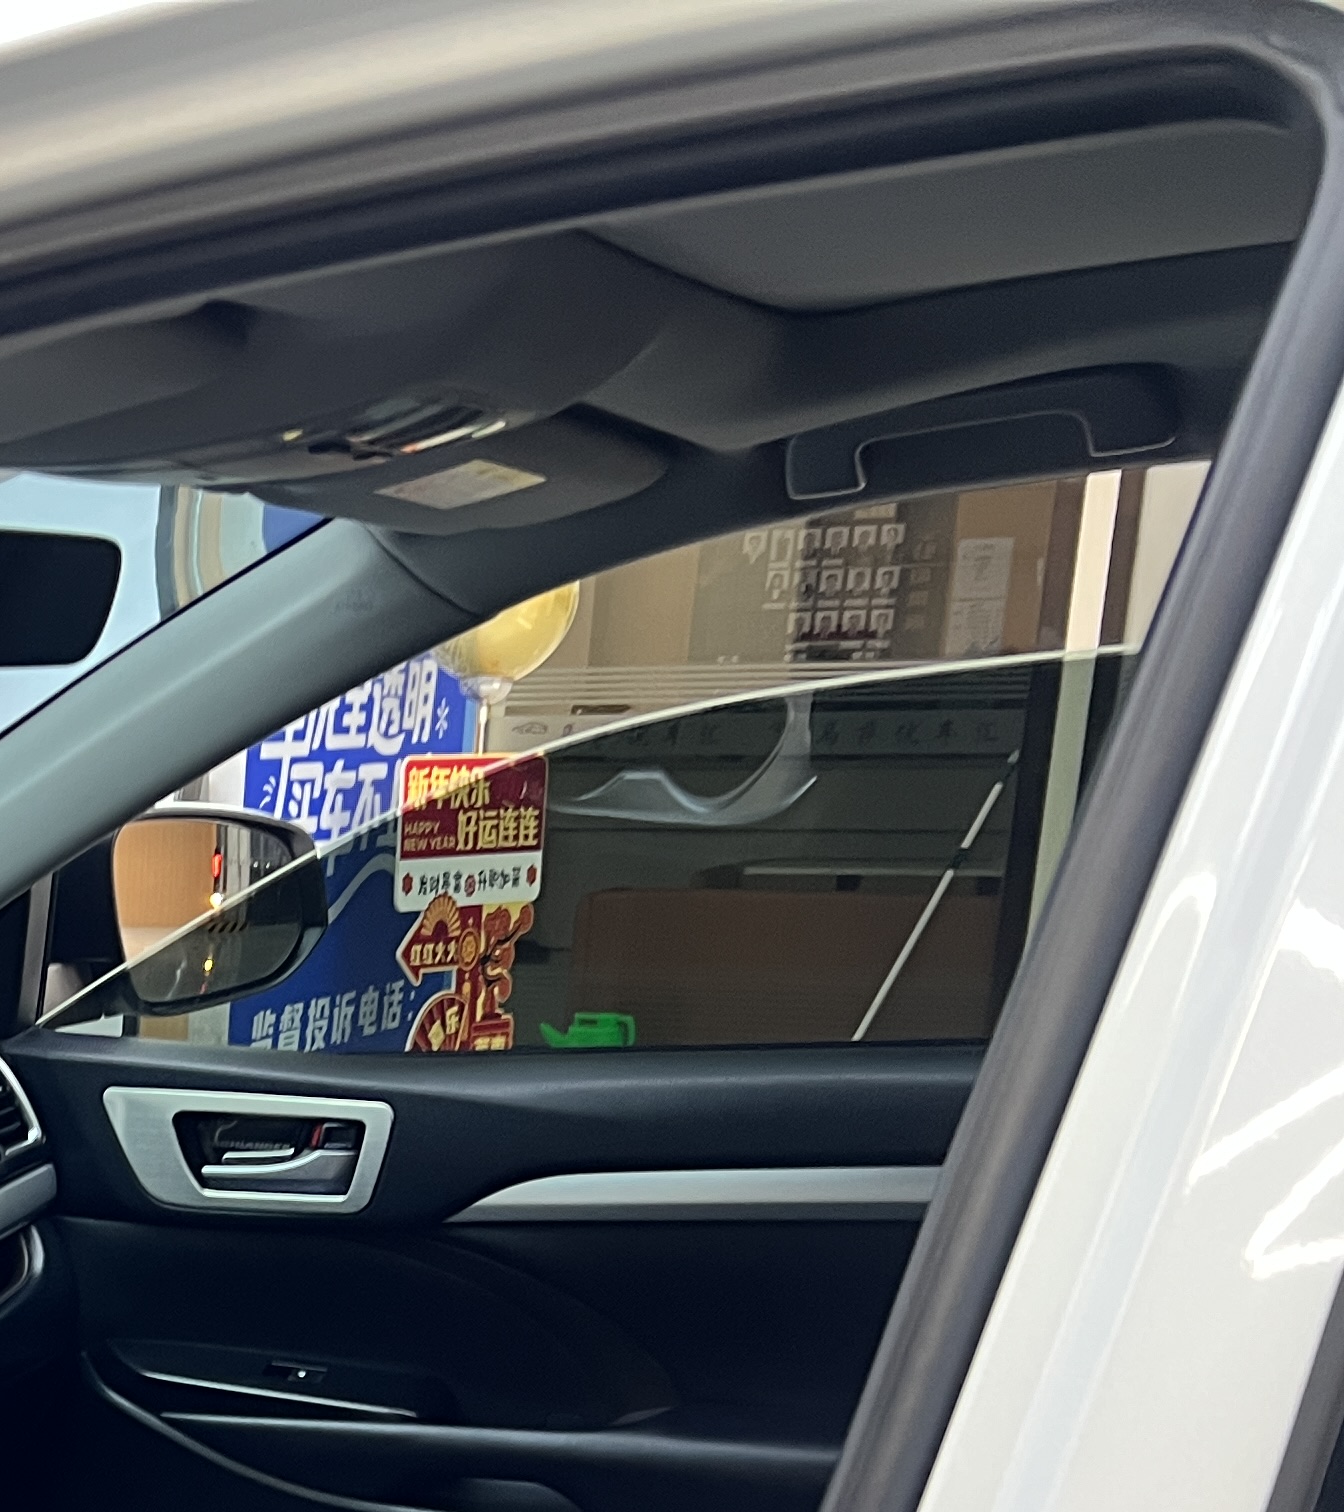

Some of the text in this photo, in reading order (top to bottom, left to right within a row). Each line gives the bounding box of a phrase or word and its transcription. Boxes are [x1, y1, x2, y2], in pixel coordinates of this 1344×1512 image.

[406, 765, 492, 811] 新年快乐
[288, 759, 400, 877] 买车不
[404, 820, 441, 835] HAPPY
[456, 805, 540, 851] 好运连连
[404, 835, 457, 852] NEW YEAR
[409, 939, 459, 966] 红红火火
